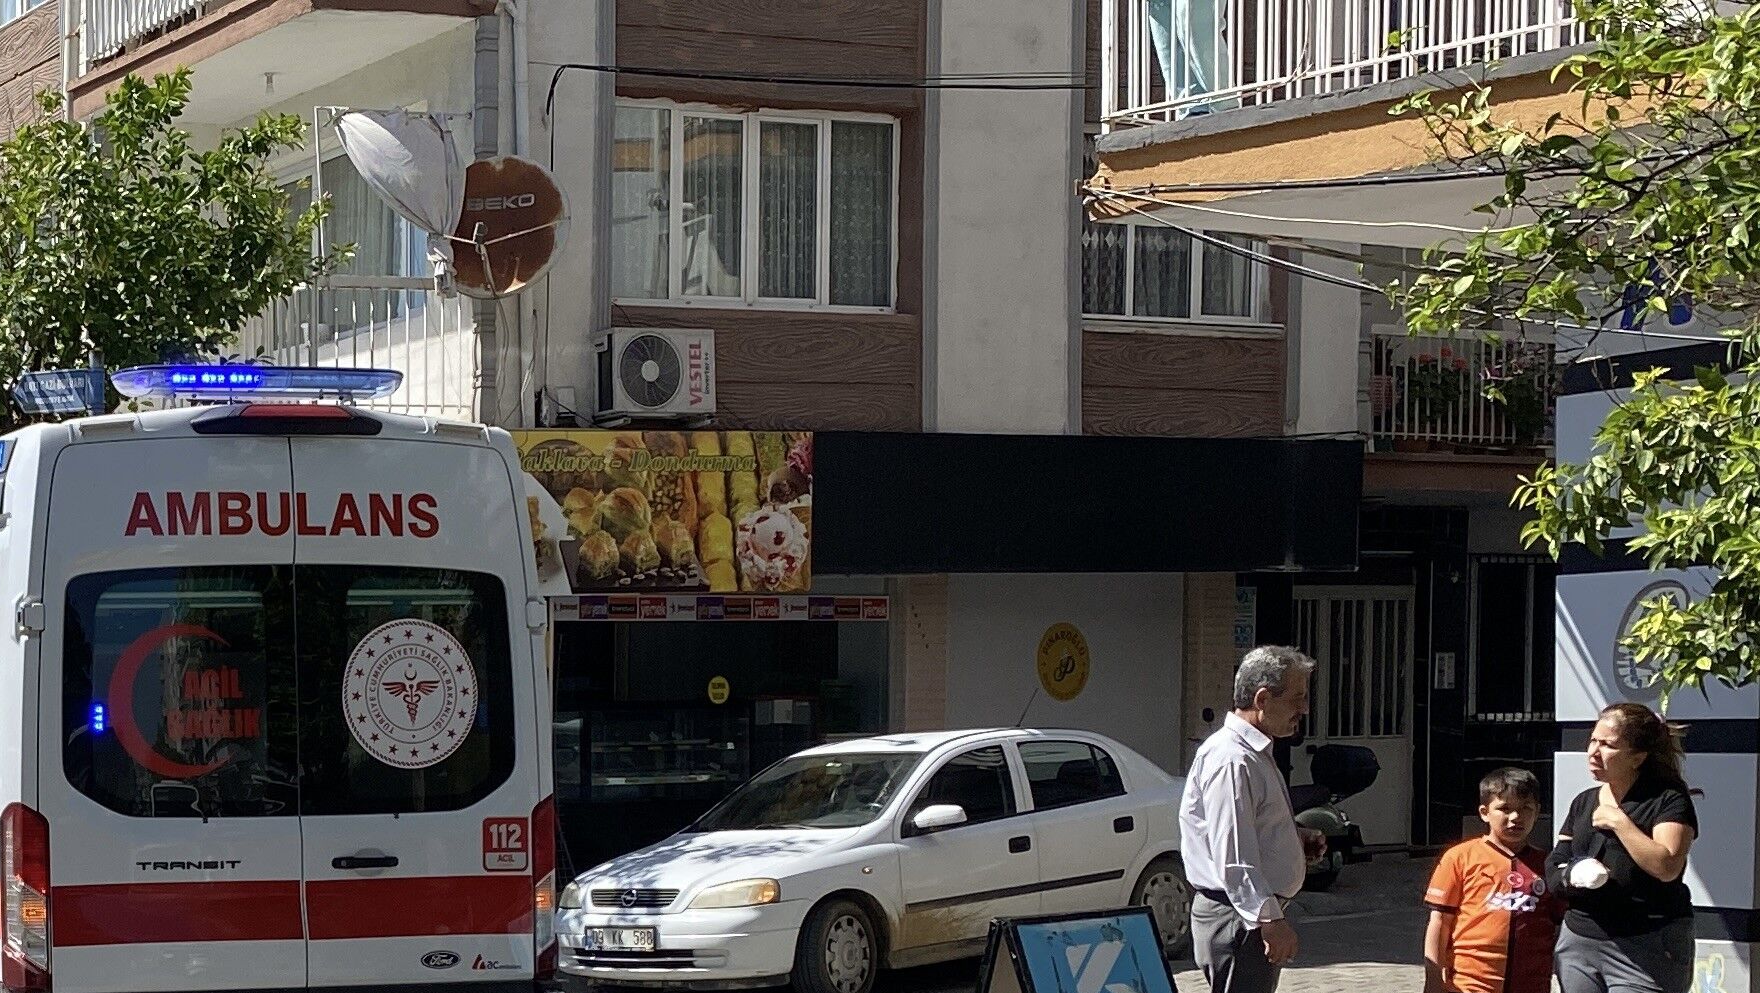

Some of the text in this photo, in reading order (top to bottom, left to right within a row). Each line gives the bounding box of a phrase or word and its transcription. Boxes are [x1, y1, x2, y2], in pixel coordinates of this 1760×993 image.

[466, 193, 535, 211] BEKO
[688, 342, 703, 406] VESTEL
[516, 449, 606, 472] aklava
[628, 448, 756, 472] Dondurma
[124, 491, 440, 538] AMBULANS
[420, 647, 448, 676] SAĞLIK
[431, 677, 453, 733] BAKANLIĞI
[489, 823, 522, 849] 112
[136, 860, 242, 871] TRANSIT
